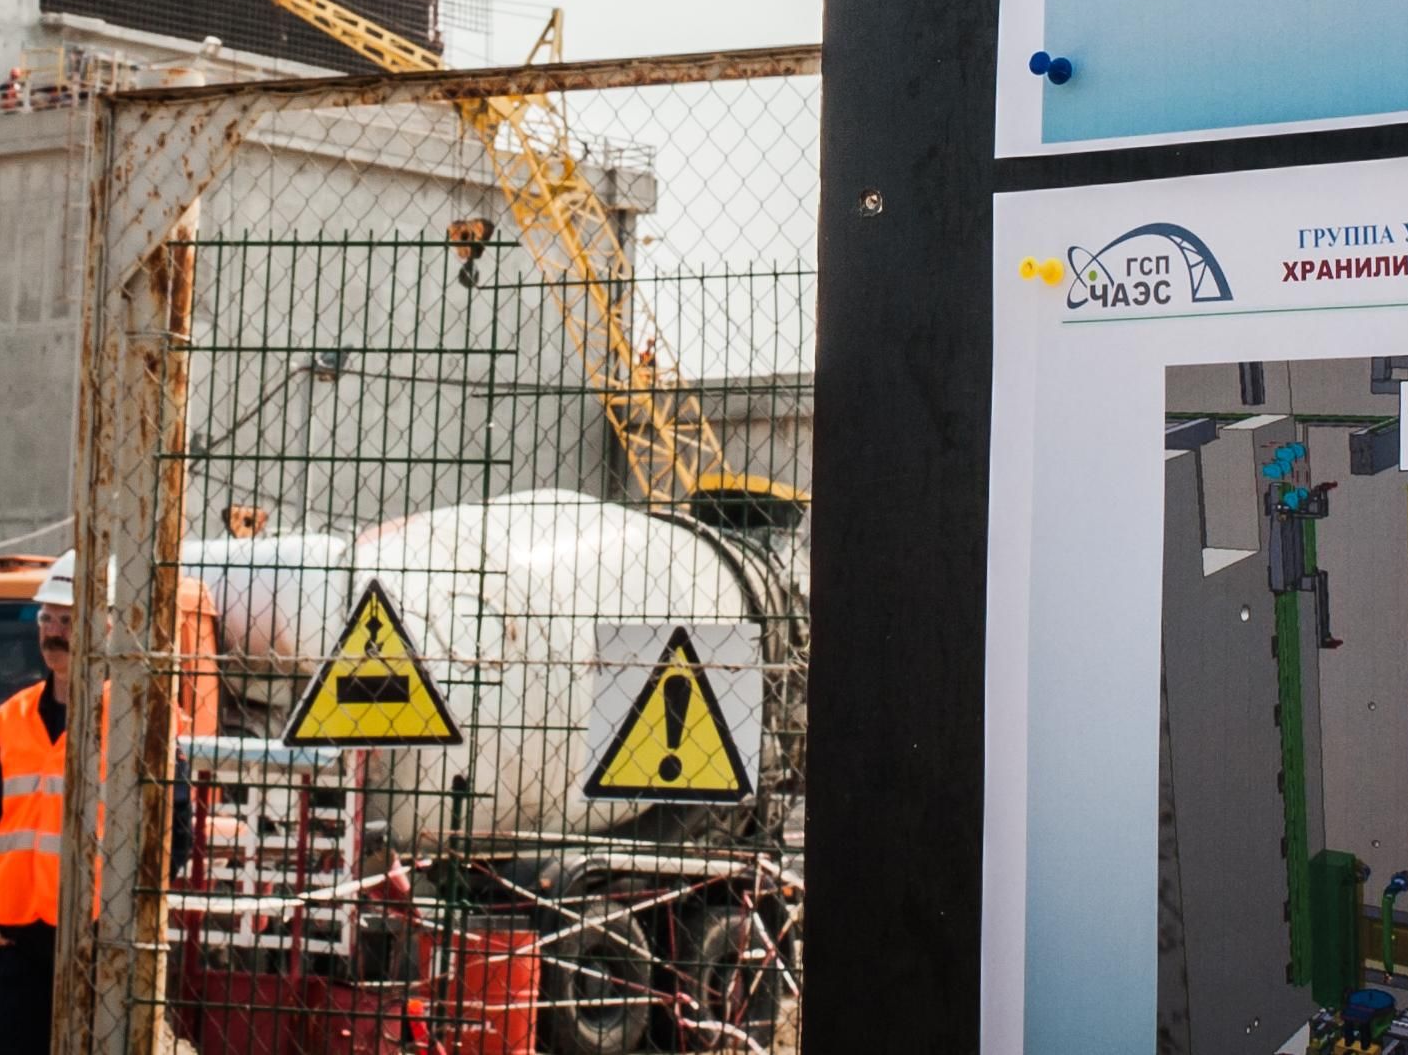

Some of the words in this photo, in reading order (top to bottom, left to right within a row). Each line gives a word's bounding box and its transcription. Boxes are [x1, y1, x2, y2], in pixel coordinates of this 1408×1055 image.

[1300, 225, 1394, 248] ГРУППА
[1127, 256, 1169, 276] ГСП
[1090, 280, 1171, 307] ЧАЭС
